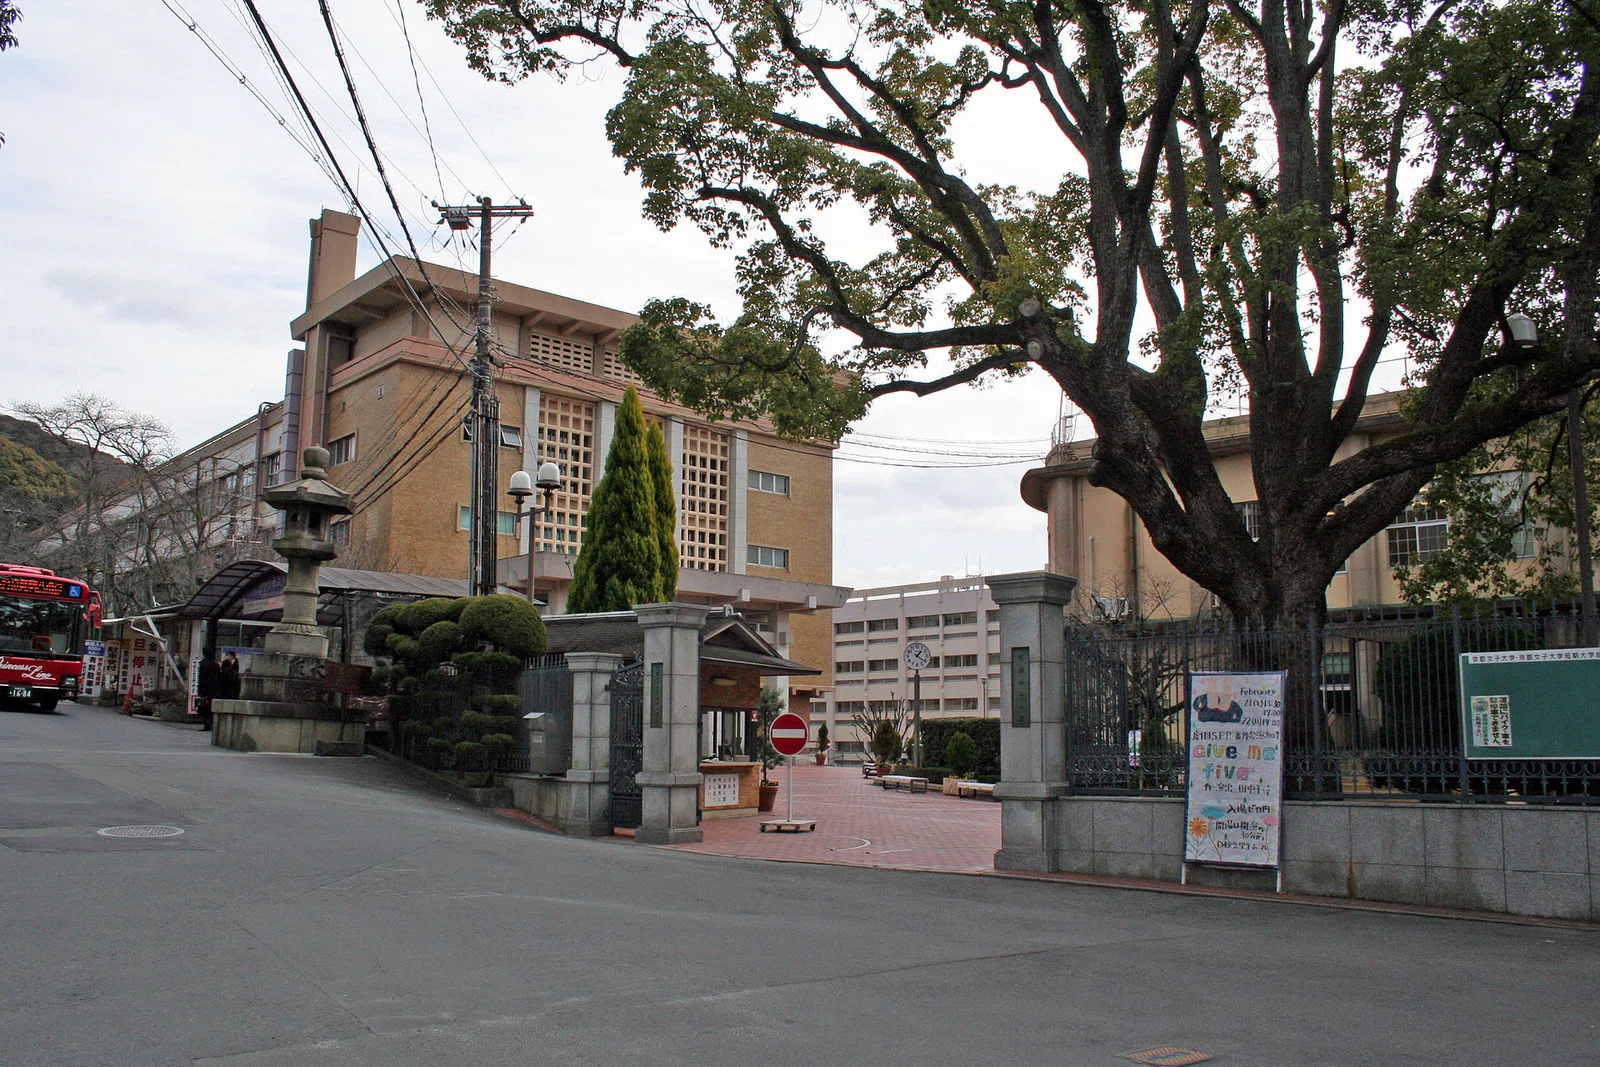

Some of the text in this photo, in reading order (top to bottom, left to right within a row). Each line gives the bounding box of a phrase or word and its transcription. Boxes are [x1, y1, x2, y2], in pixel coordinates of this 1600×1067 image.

[21, 665, 57, 681] Line
[1240, 687, 1276, 696] February
[1247, 745, 1276, 761] me
[1203, 763, 1249, 781] five
[1226, 803, 1271, 815] 入場ゼロ円
